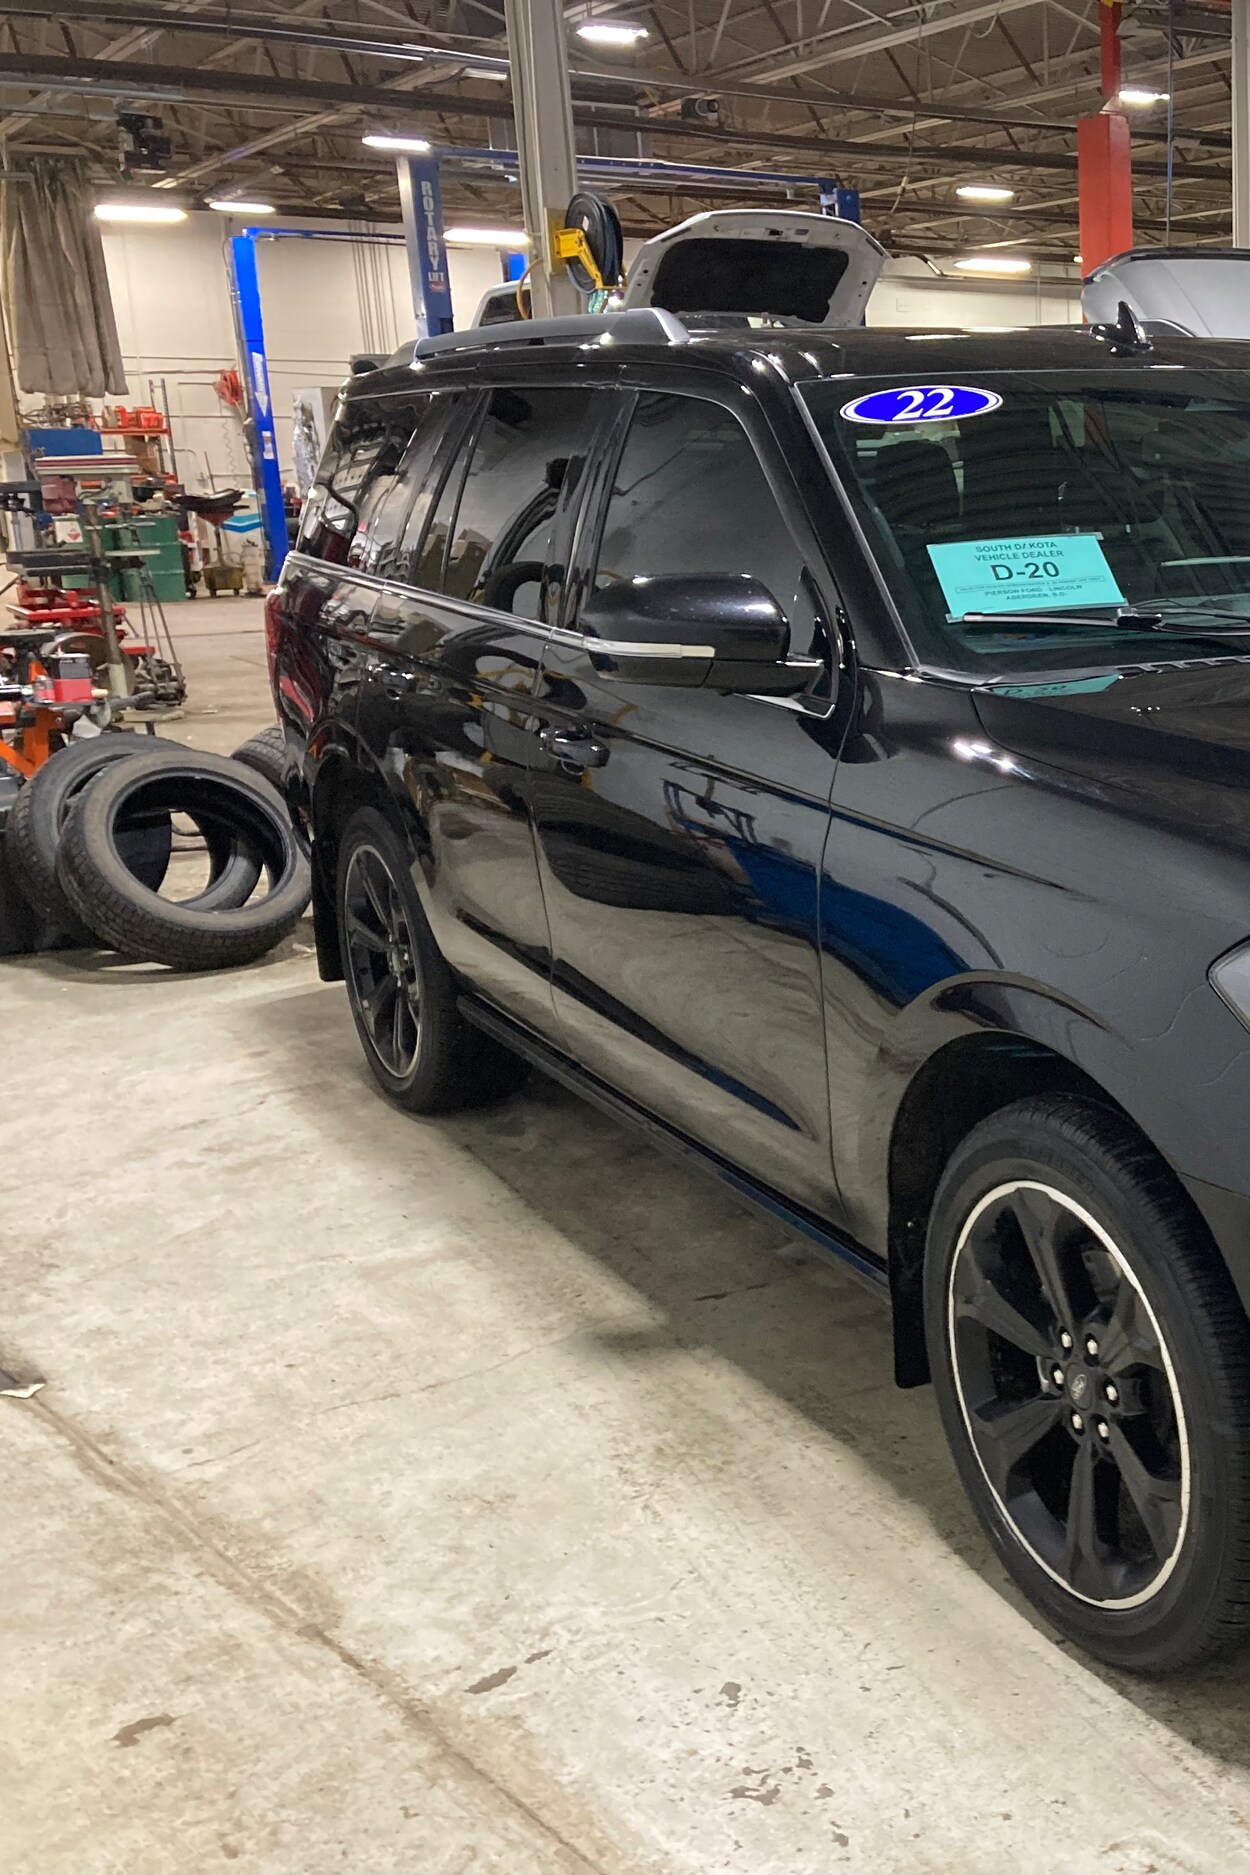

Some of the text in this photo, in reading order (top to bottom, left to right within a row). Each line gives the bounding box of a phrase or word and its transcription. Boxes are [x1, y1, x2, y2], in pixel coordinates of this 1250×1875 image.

[420, 180, 440, 271] ROTARY
[428, 271, 445, 282] LIFT
[892, 388, 955, 421] 22
[975, 543, 1012, 553] SOUTH
[974, 549, 1065, 562] VEHICLE DEALER
[990, 561, 1060, 581] D-20
[984, 587, 1019, 597] PIERSON
[1021, 586, 1043, 594] FORD
